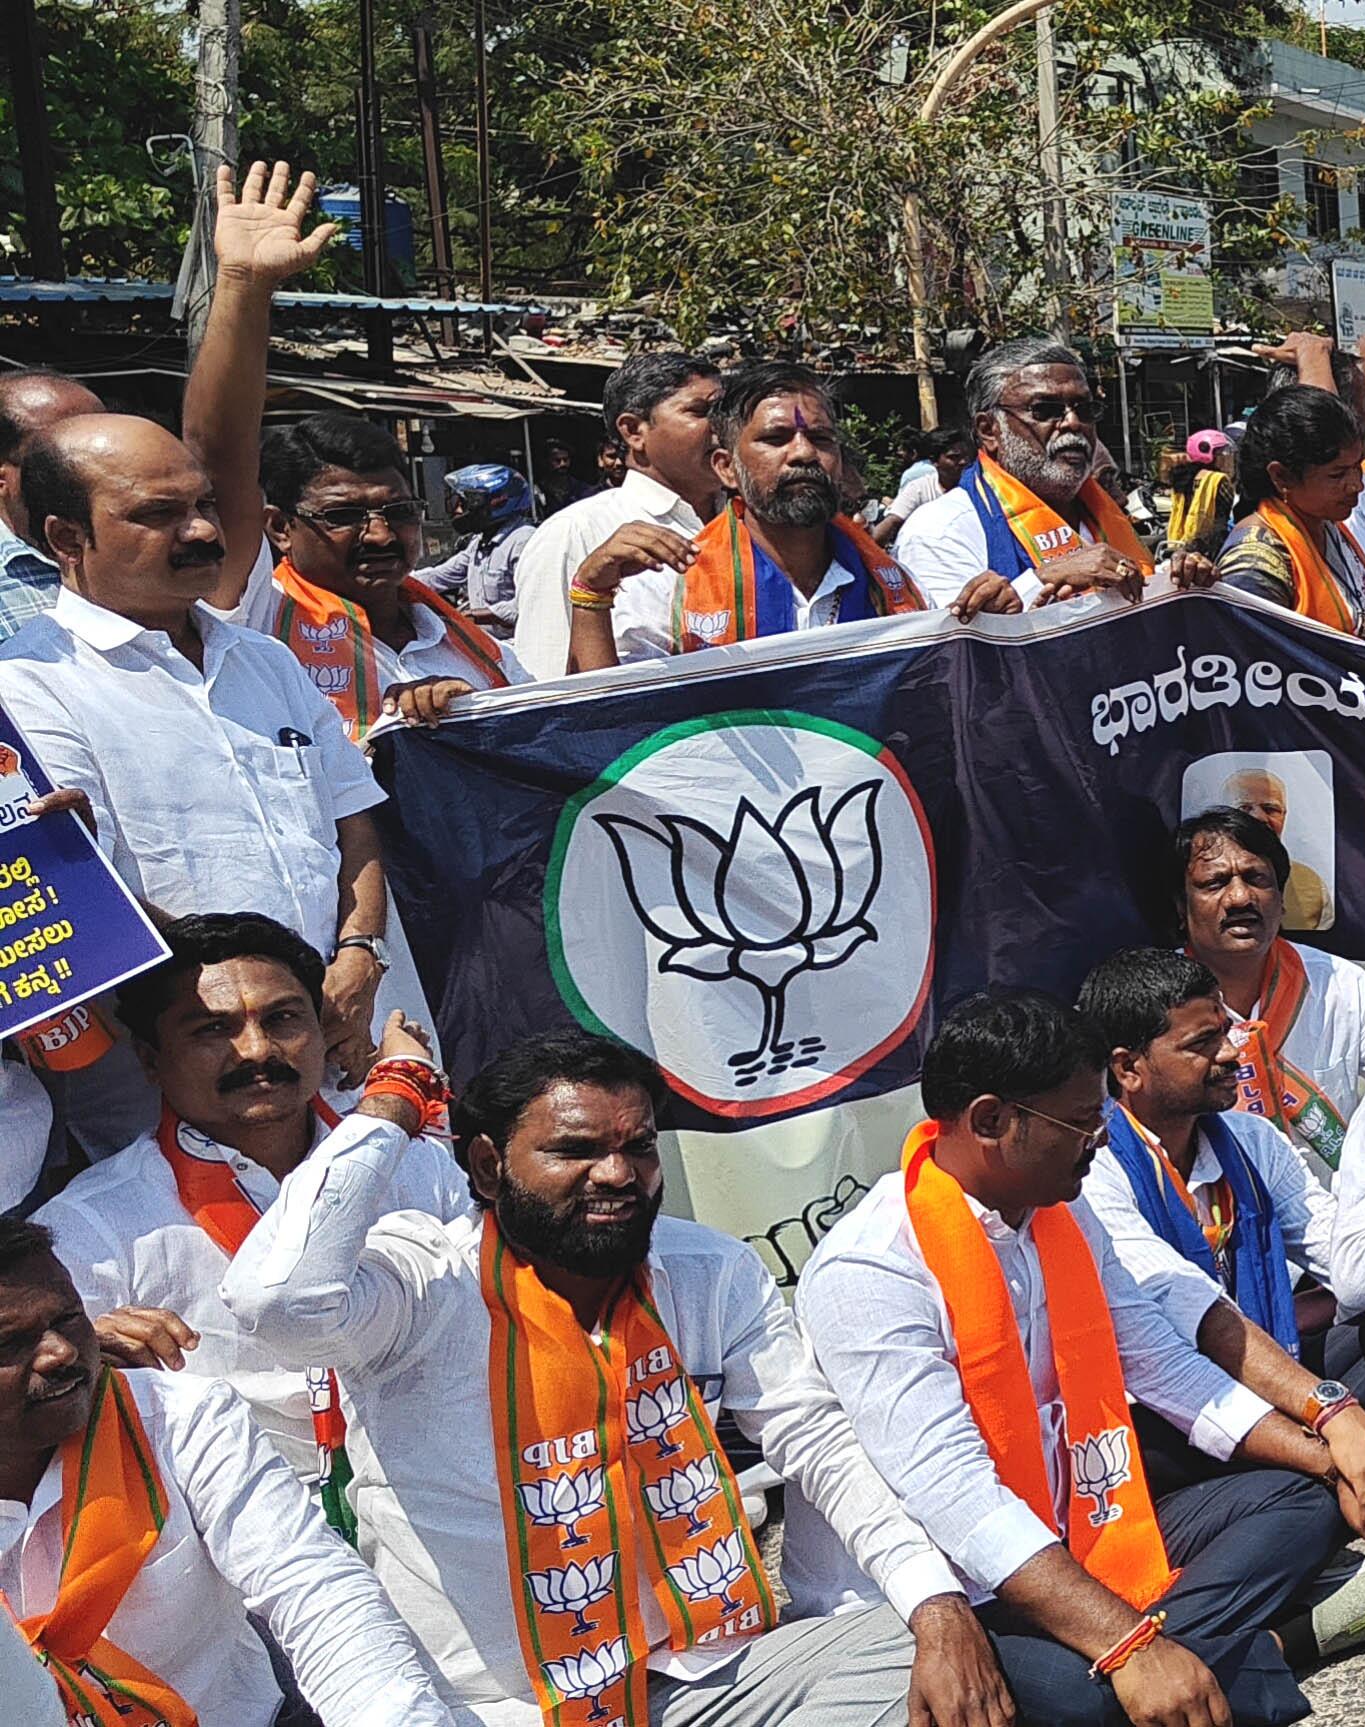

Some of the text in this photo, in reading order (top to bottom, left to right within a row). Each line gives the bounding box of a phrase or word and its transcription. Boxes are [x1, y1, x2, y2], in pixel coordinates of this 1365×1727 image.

[1133, 221, 1193, 241] GREENLINE
[1034, 526, 1073, 552] BJP
[38, 1004, 91, 1051] BJP
